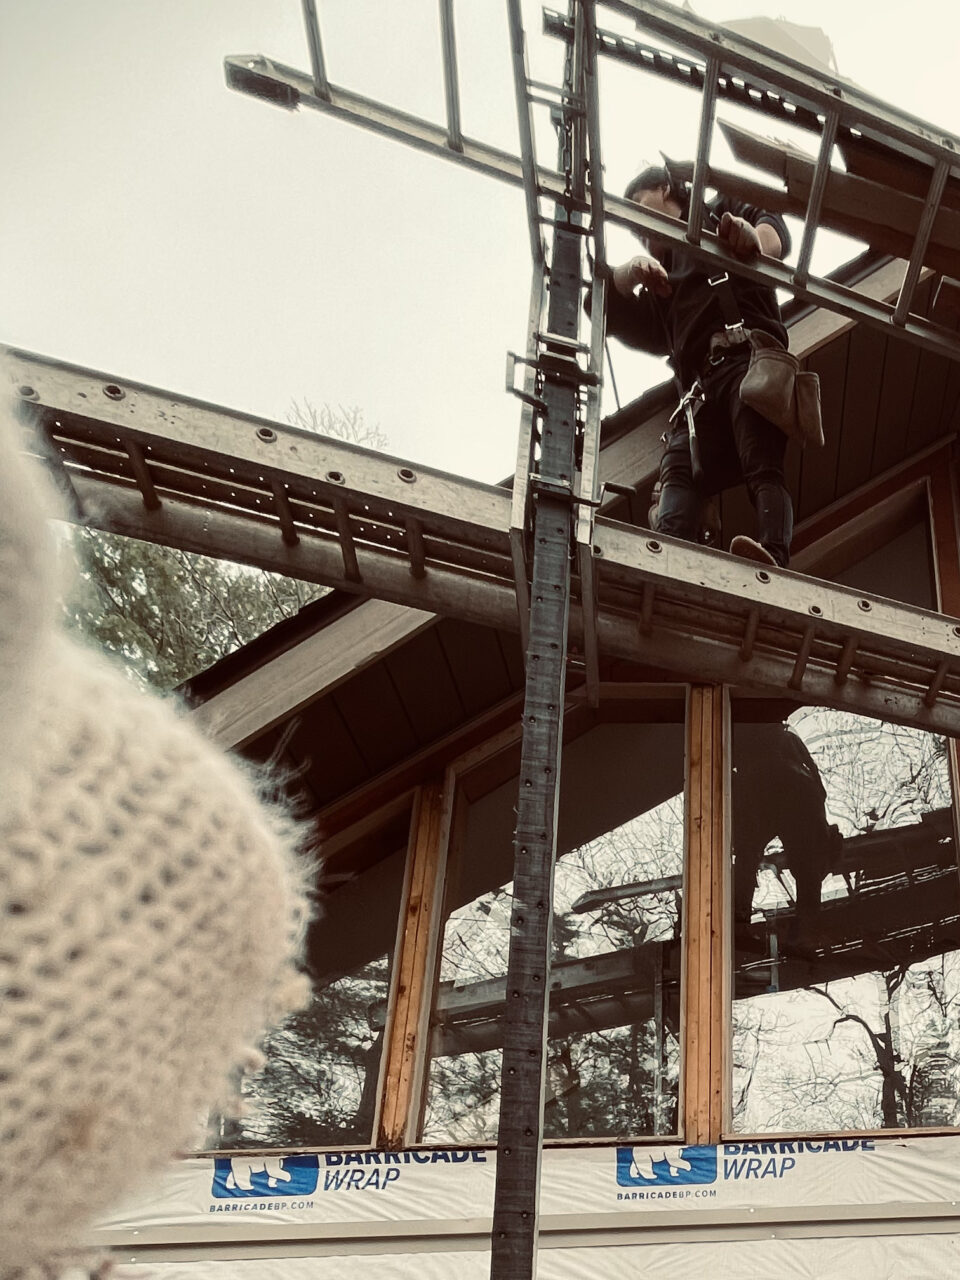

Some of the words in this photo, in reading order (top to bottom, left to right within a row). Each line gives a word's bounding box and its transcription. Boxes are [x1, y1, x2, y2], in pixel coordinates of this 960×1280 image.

[723, 1157, 796, 1180] WRAP
[323, 1167, 401, 1191] WRAP
[616, 1189, 718, 1201] BARRICADEBP.COM
[209, 1201, 315, 1213] BARRICADEBP.COM
